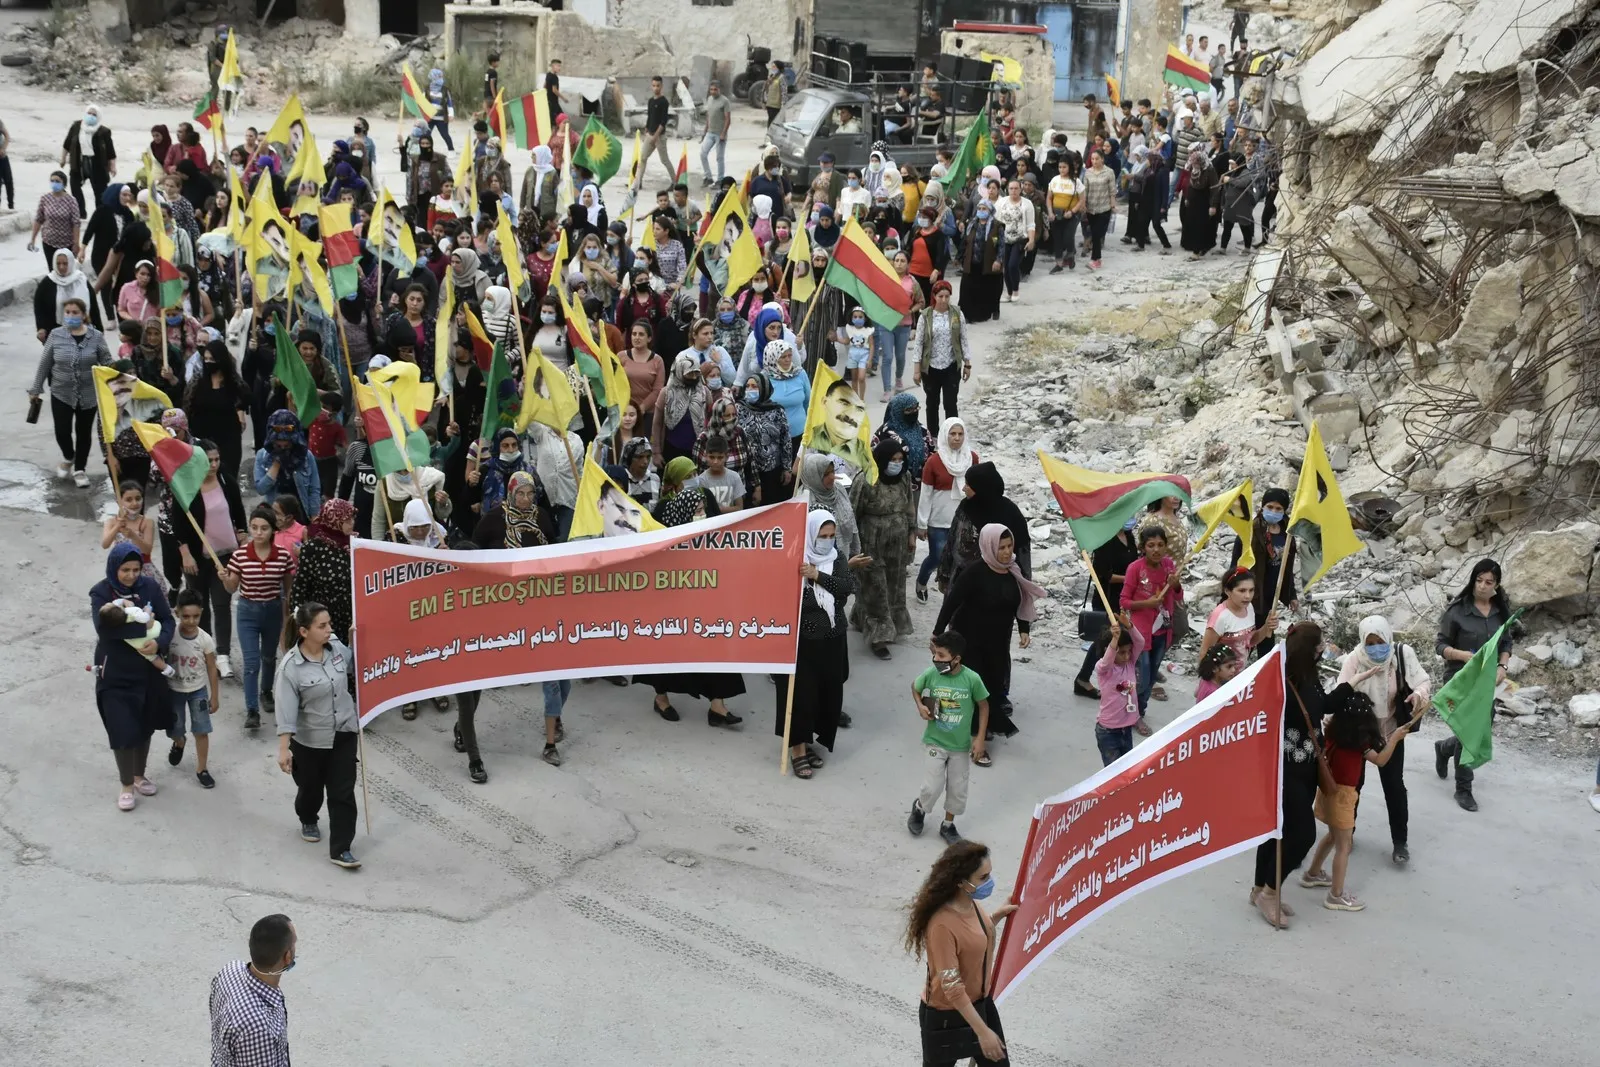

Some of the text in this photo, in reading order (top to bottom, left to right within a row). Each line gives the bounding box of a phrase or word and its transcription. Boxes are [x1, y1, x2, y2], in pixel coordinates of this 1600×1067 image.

[364, 571, 380, 596] LI
[382, 561, 459, 590] HEMBE
[409, 569, 718, 621] EM Ê TEKOŞÎNÊ BILIND BIKIN
[464, 628, 526, 653] الهجمات
[530, 620, 564, 650] أمام
[568, 620, 629, 644] والنضال
[633, 617, 688, 640] المقاومة
[693, 617, 735, 638] وتيرة
[739, 617, 790, 639] سنرفع
[404, 638, 461, 669] الوحشية
[362, 655, 401, 684] والإبادة
[1048, 823, 1056, 849] Û
[1178, 739, 1193, 762] BI
[1199, 710, 1268, 754] BINKEVÊ
[1138, 788, 1183, 823] مقاومة
[1088, 812, 1134, 860] حفتانين
[1046, 843, 1086, 897] ستنتصر
[1023, 821, 1210, 953] وستسقط الخيانة والفاشية التركية
